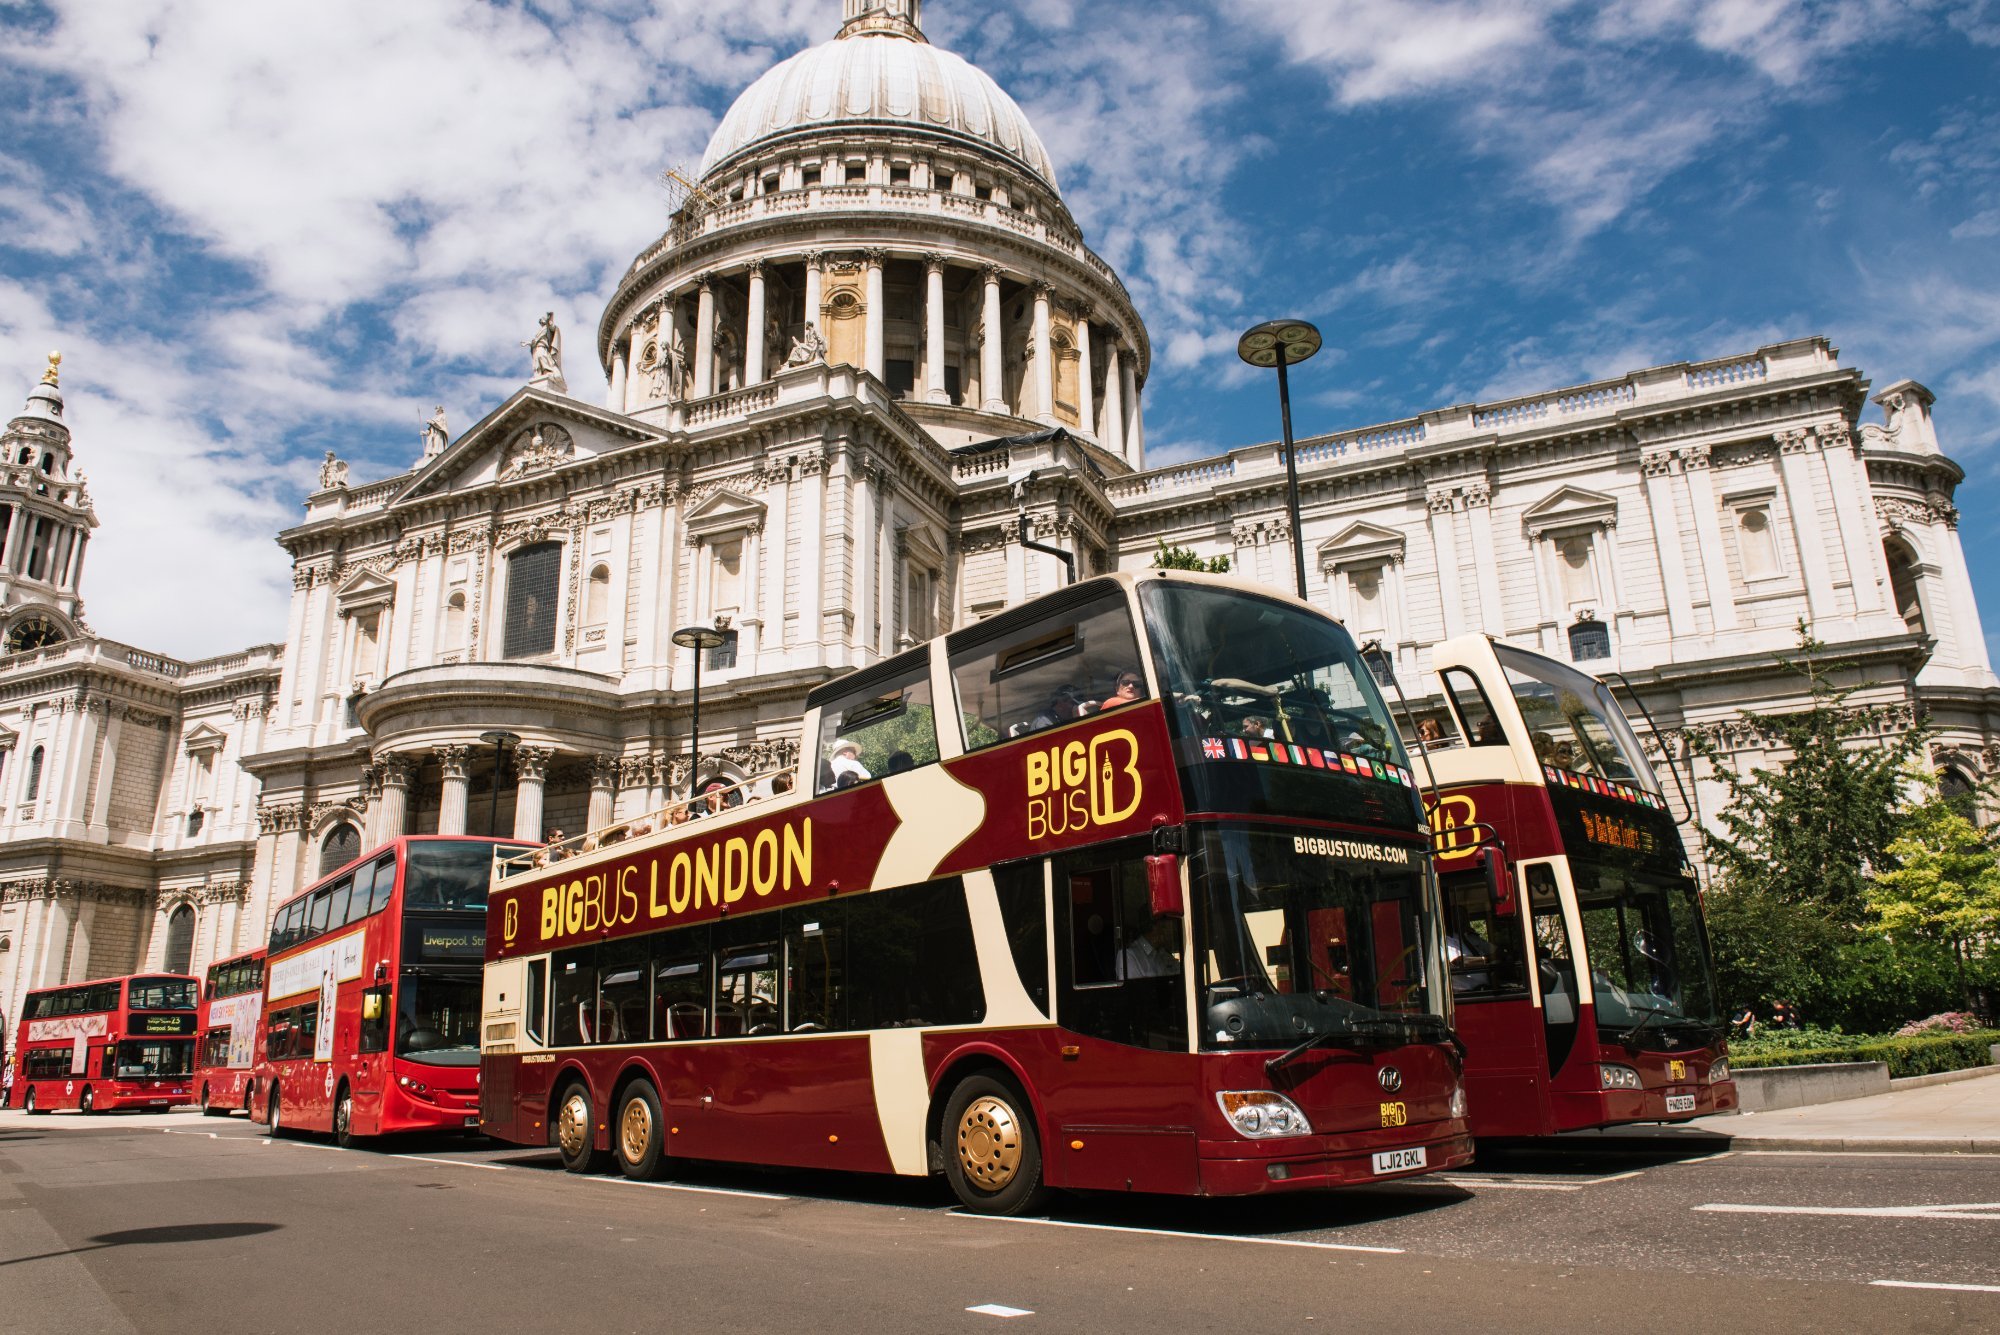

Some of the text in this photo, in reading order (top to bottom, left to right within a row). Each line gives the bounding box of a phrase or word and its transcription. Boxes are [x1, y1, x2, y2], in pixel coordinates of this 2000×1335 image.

[1027, 741, 1087, 797] BIG
[1029, 789, 1088, 840] BUS
[1294, 836, 1408, 865] BIGBUSTOURS.COM
[650, 817, 812, 919] LONDON
[423, 933, 468, 949] Liverpool
[171, 1016, 180, 1024] 23
[1380, 1103, 1396, 1116] BIG
[1381, 1115, 1397, 1128] BUS
[1379, 1149, 1422, 1171] LJ12 GKL
